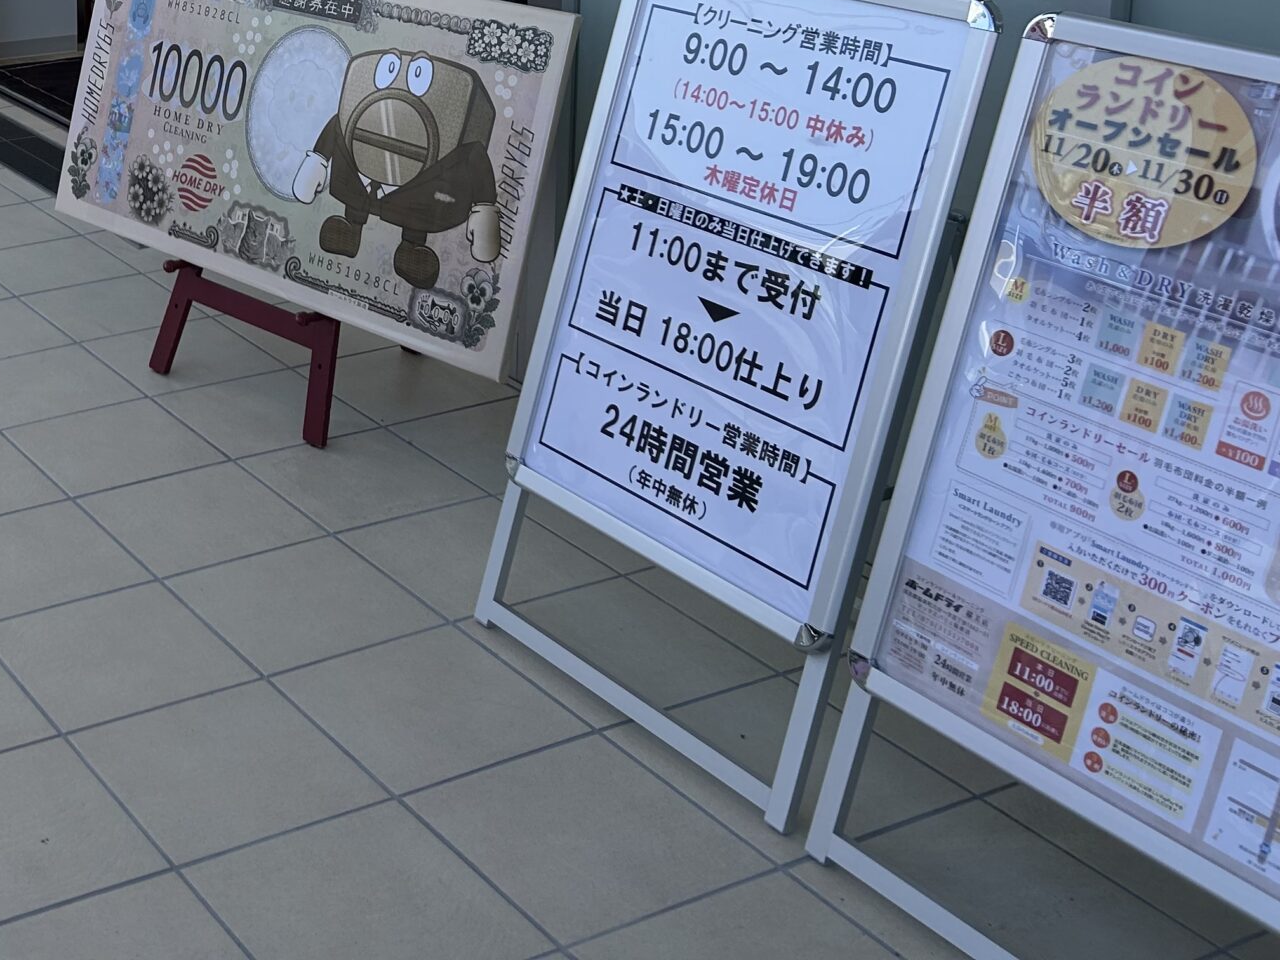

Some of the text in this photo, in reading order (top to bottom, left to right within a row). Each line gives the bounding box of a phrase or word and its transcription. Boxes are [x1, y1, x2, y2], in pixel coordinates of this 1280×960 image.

[694, 2, 894, 68] 【クリーニング営業時間】
[148, 40, 248, 122] 10000
[682, 32, 748, 76] 9:00
[805, 60, 898, 114] 14:00
[1113, 61, 1204, 100] コイン
[153, 104, 224, 136] HOME DRY
[1076, 83, 1228, 134] ランドリー
[163, 121, 208, 144] CLEANING
[1047, 106, 1241, 174] オープンセール
[647, 108, 725, 160] 15:00
[780, 147, 871, 205] 19:00
[172, 169, 226, 197] HOME DRY
[703, 163, 799, 213] 木曜定休日
[1071, 179, 1169, 244] 半額
[308, 251, 400, 297] WH851028CL
[630, 220, 822, 321] 11:00まで受付
[1012, 278, 1027, 294] M
[1052, 242, 1111, 275] Wash
[1135, 269, 1195, 300] DRY
[1108, 312, 1136, 329] WASH
[1151, 328, 1178, 343] DRY
[594, 289, 824, 411] 当日 18:00仕上り
[1143, 355, 1170, 372] ¥100
[1194, 341, 1224, 359] WASH
[1195, 352, 1218, 367] DRY
[1092, 368, 1120, 386] WASH
[1134, 385, 1161, 401] DRY
[575, 351, 813, 485] 【コインランドリー営業時間】
[1126, 411, 1153, 429] ¥100
[1177, 400, 1206, 418] WASH
[1178, 409, 1201, 425] DRY
[1025, 406, 1151, 463] コインランドリーセール
[599, 403, 764, 514] 24時間営業
[952, 487, 981, 509] Smart
[983, 500, 1023, 528] Laundry
[1116, 549, 1151, 573] Laundry
[904, 578, 964, 613] ホームドライ
[1009, 632, 1040, 654] SPEED
[1039, 648, 1090, 682] CLEANING
[1013, 661, 1055, 693] 11:00
[1000, 695, 1043, 728] 18:00
